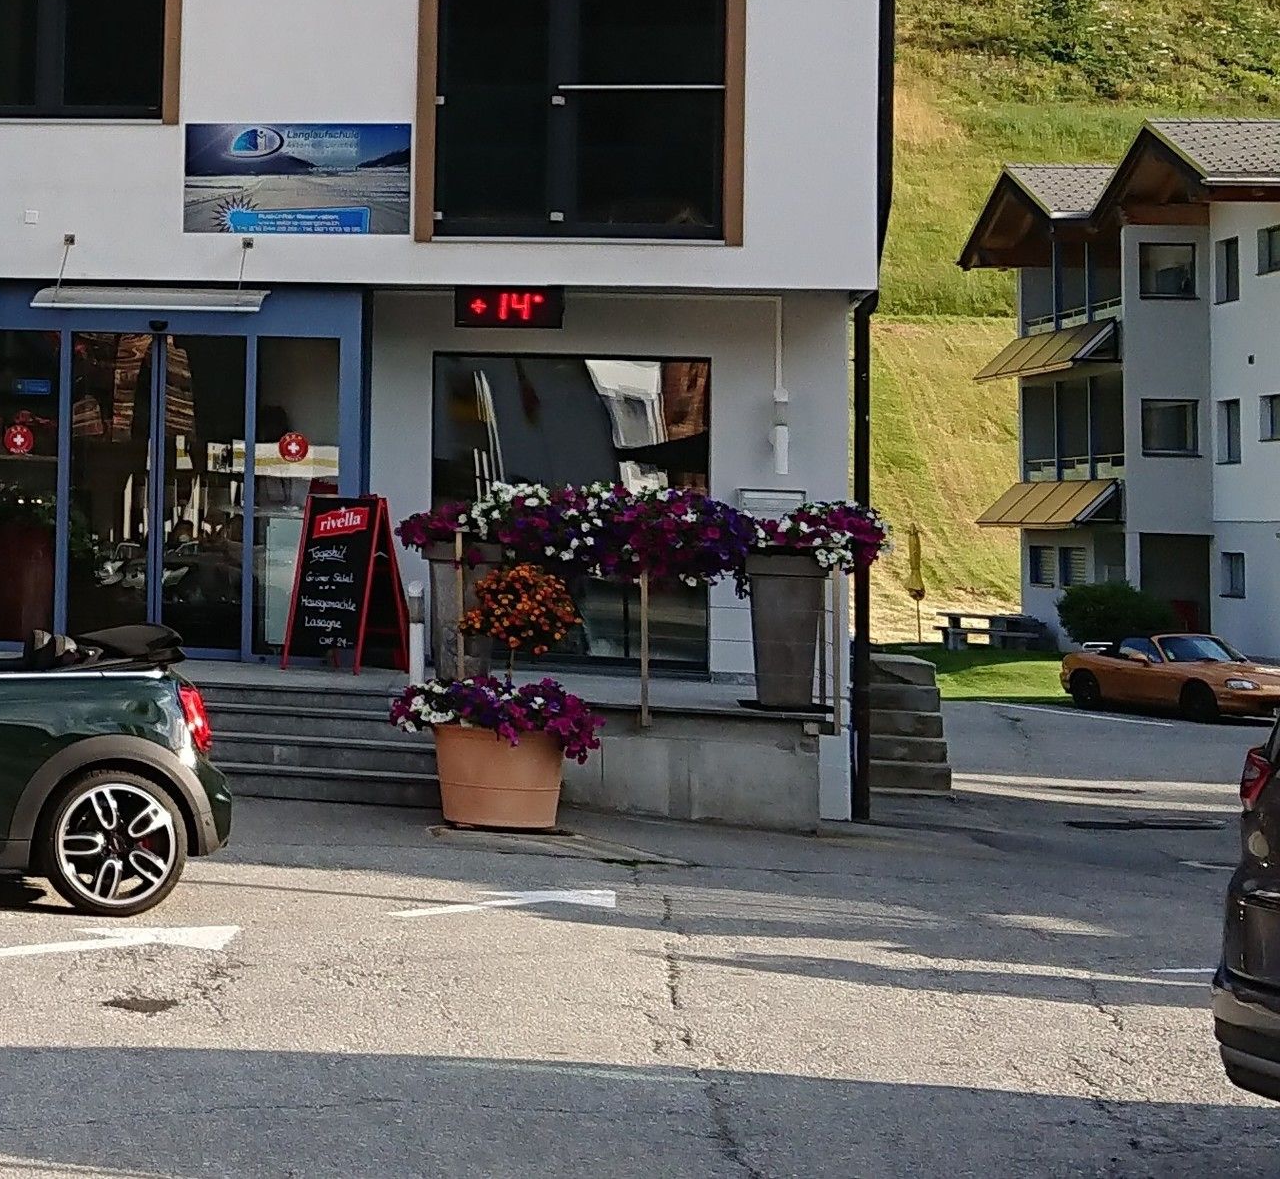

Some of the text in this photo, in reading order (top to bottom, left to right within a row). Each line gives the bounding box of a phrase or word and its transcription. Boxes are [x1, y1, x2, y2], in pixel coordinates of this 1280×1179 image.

[320, 512, 362, 531] rivella
[301, 595, 357, 613] Hausgemachte
[304, 616, 342, 632] Lasagne
